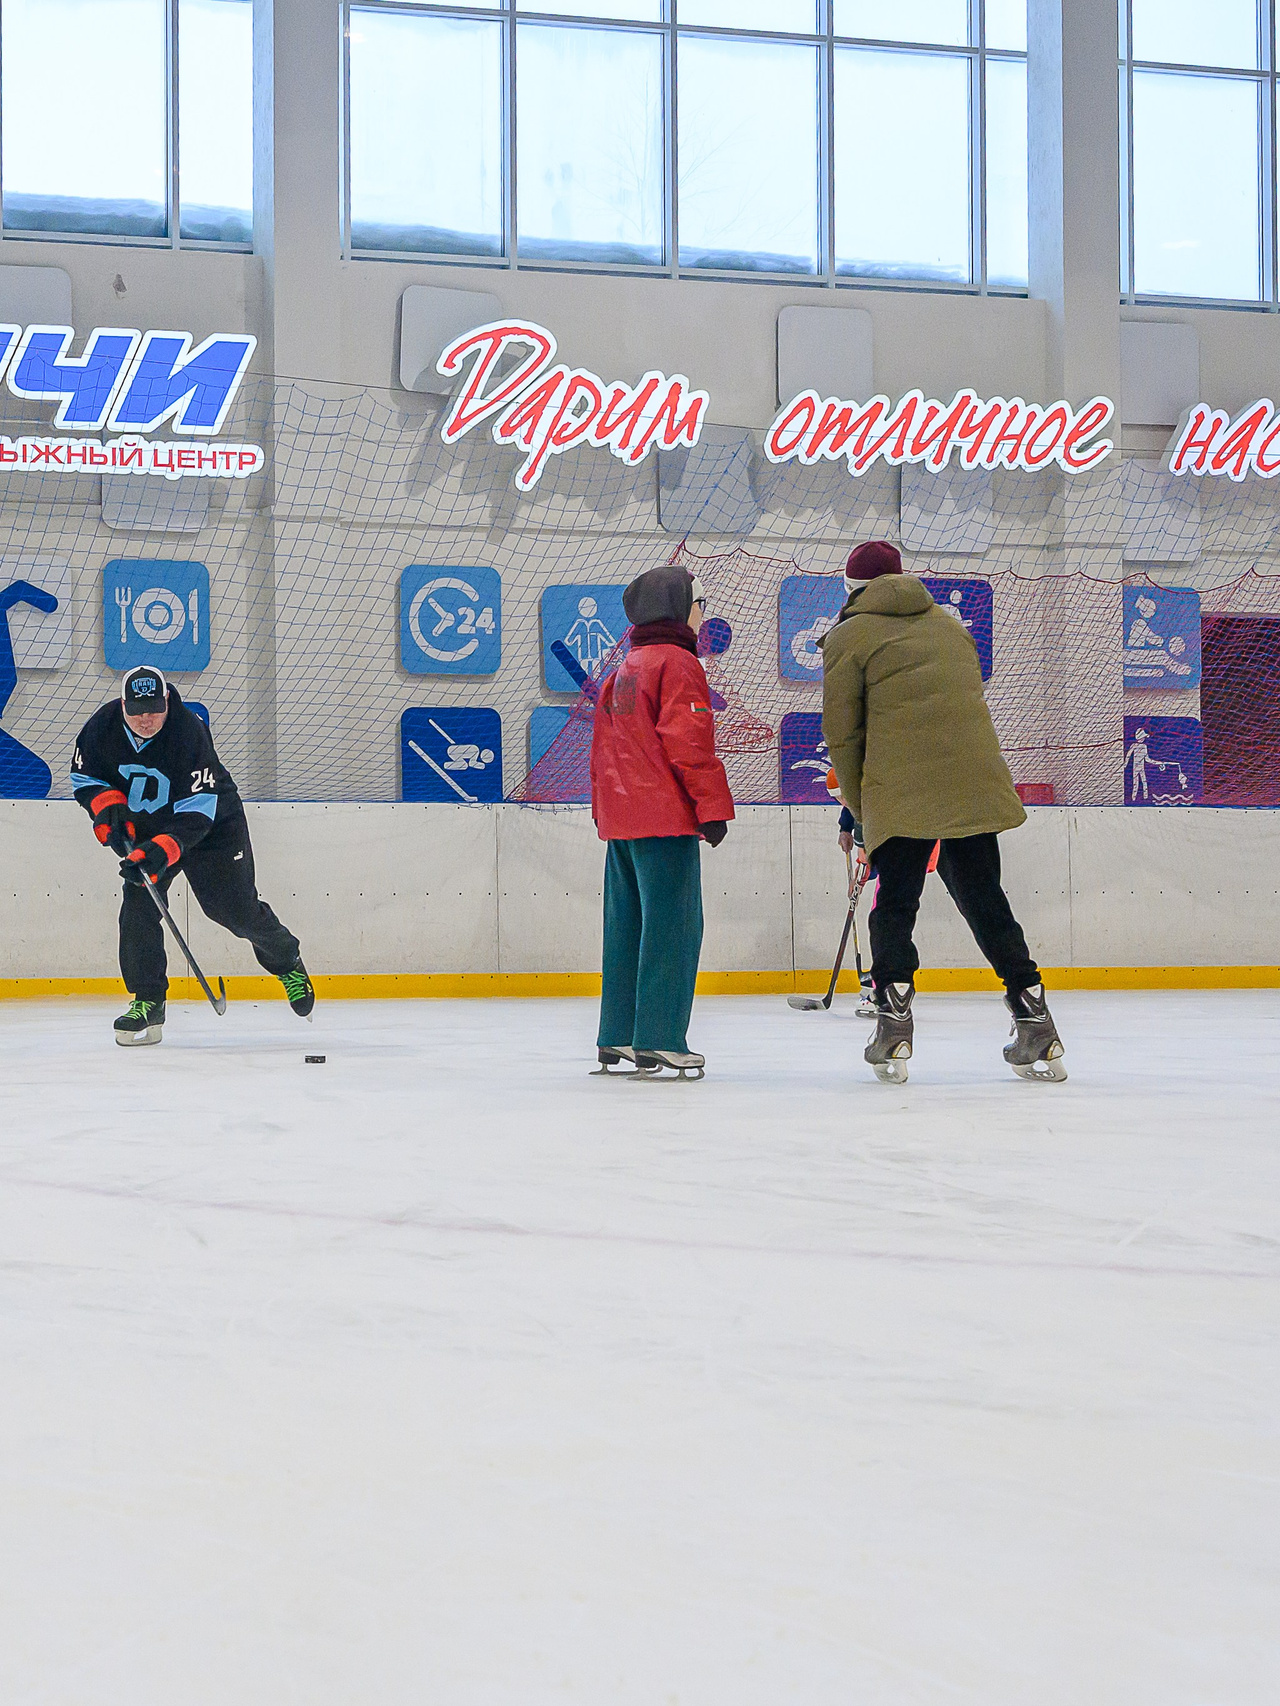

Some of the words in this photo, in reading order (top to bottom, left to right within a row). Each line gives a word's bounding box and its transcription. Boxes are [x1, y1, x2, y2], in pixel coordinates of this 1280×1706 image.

[444, 327, 703, 483] Дарим
[770, 395, 1108, 471] отличное
[153, 448, 257, 472] ЦЕНТР
[457, 606, 495, 635] 24
[190, 767, 216, 793] 24
